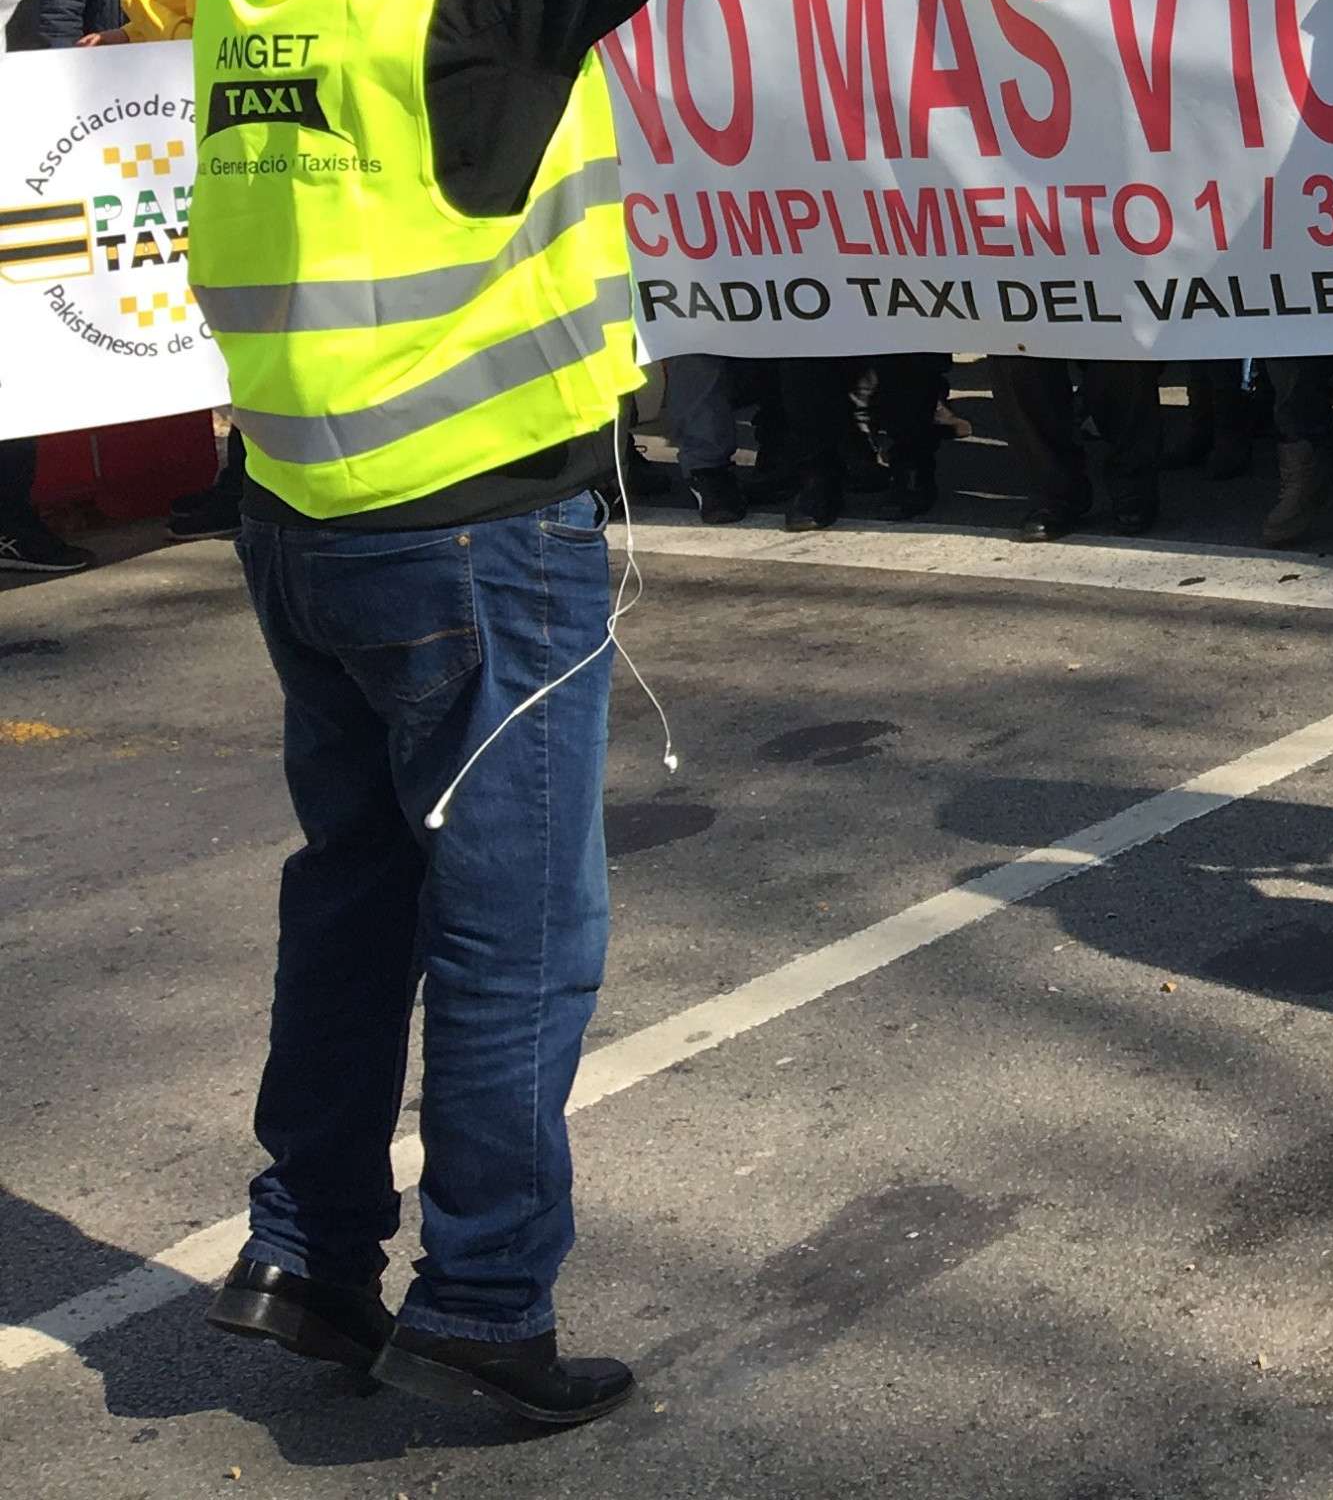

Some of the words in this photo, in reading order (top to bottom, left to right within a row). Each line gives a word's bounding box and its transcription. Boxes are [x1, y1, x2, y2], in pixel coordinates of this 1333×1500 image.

[216, 34, 319, 70] ANGET
[225, 87, 303, 116] TAXI
[210, 153, 287, 175] Generació
[298, 153, 382, 174] Taxistes
[623, 183, 1175, 260] CUMPLIMIENTO
[43, 284, 158, 357] Pakistanesos
[168, 334, 194, 354] de
[639, 278, 832, 325] RADIO
[847, 277, 981, 323] TAXI
[998, 279, 1123, 324] DEL
